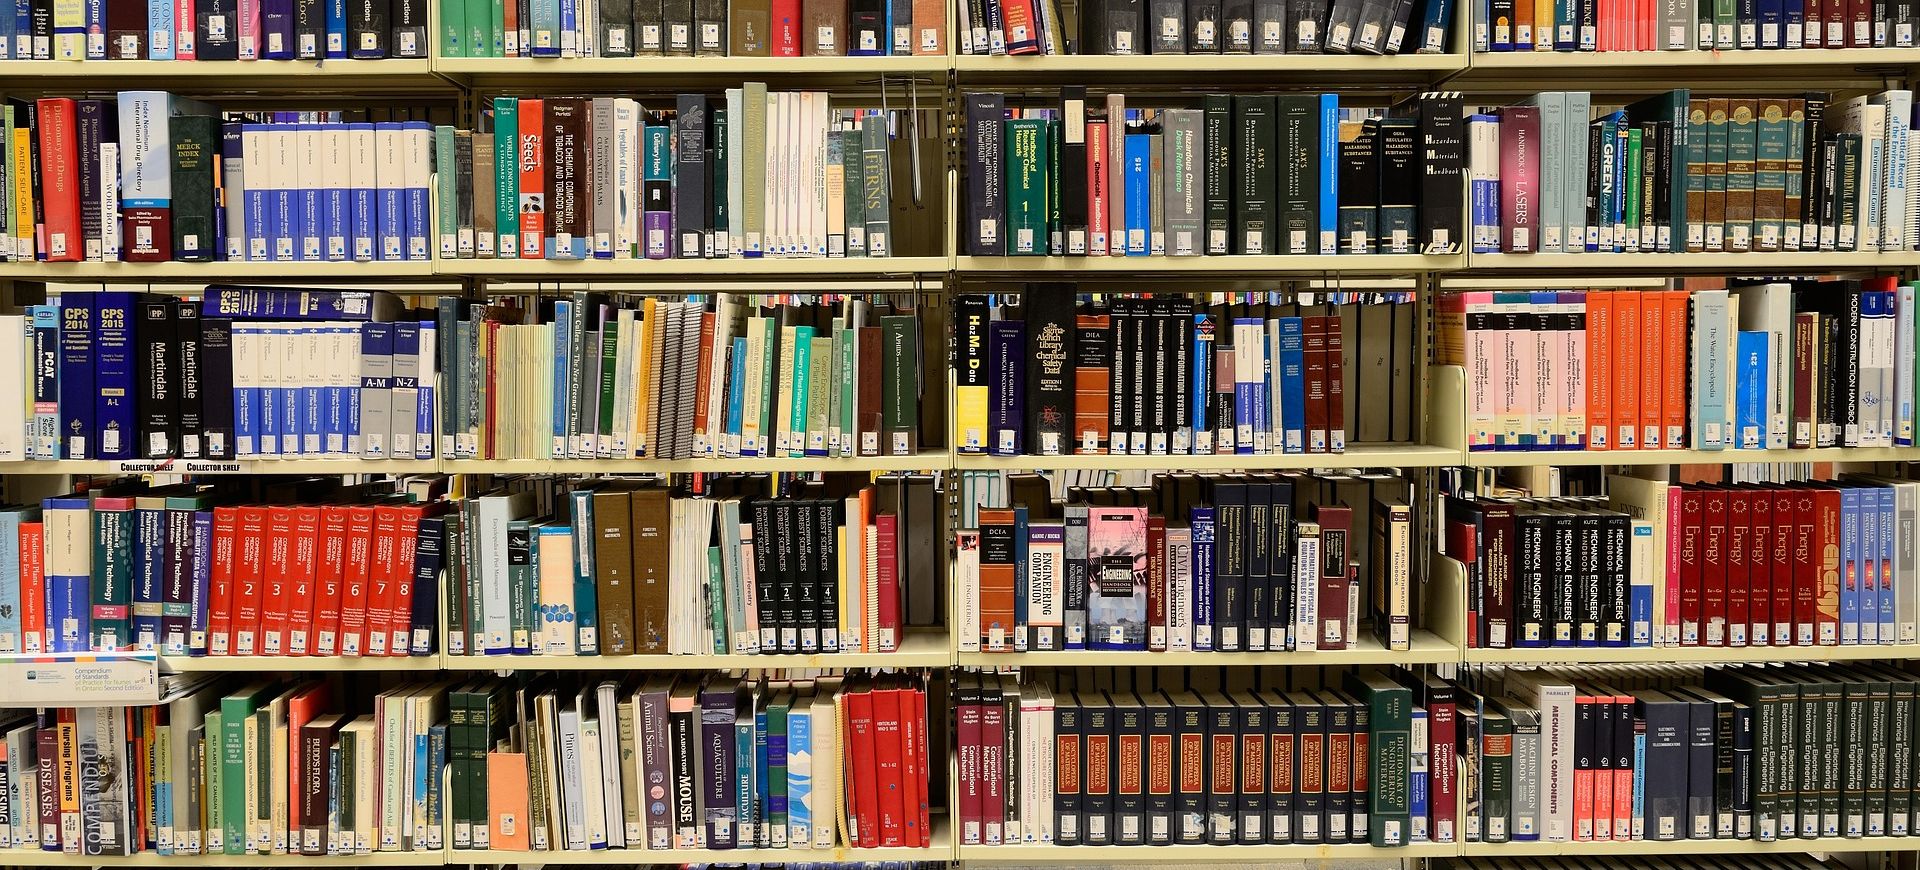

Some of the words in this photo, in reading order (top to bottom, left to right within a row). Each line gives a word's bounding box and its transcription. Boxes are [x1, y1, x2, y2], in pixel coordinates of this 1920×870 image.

[92, 0, 100, 23] GUIDE
[54, 105, 62, 153] Dictionary
[556, 125, 563, 133] OF
[565, 134, 573, 146] THE
[1093, 126, 1101, 161] Hazardous
[1425, 134, 1460, 144] Hazardous
[1899, 124, 1908, 160] Statistical
[57, 155, 63, 164] of
[523, 134, 538, 172] Seeds
[565, 148, 573, 179] CHEMICAL
[1030, 164, 1037, 172] of
[1426, 150, 1459, 160] Materials
[866, 154, 880, 209] FERNS
[1093, 162, 1101, 196] Chemicals
[1426, 165, 1459, 175] Handbook
[1519, 168, 1525, 176] OF
[1603, 143, 1614, 194] GREEN
[1872, 147, 1880, 192] Environmental
[565, 182, 574, 224] COMPONENTS
[1516, 181, 1528, 224] LASERS
[65, 308, 89, 319] CPS
[101, 309, 124, 319] CPS
[220, 290, 230, 314] CPS
[231, 291, 240, 314] 2015
[310, 297, 319, 311] M-Z
[65, 320, 88, 329] 2014
[102, 320, 124, 328] 2015
[969, 315, 980, 358] HazMat
[1036, 352, 1066, 360] Chemical
[1039, 342, 1063, 350] Library
[45, 352, 54, 378] PCAT
[156, 342, 165, 400] Martindale
[186, 342, 196, 399] Martindale
[969, 359, 980, 383] Data
[1043, 360, 1062, 368] Safety
[366, 379, 386, 387] A-M
[396, 378, 414, 387] N-Z
[1114, 395, 1122, 425] SYSTEMS
[187, 463, 221, 471] COLLECTOR
[1682, 525, 1700, 565] Energy
[1706, 525, 1724, 565] Energy
[1730, 526, 1748, 565] Energy
[1752, 526, 1769, 565] Energy
[1775, 525, 1792, 564] Energy
[1796, 524, 1814, 564] Energy
[1102, 566, 1132, 581] ENGINEERING
[1177, 545, 1188, 578] CIVIL
[104, 564, 113, 601] Technology
[219, 584, 224, 595] 1
[245, 584, 253, 595] 2
[272, 584, 280, 596] 3
[297, 584, 306, 595] 4
[327, 584, 335, 595] 5
[351, 584, 359, 596] 6
[377, 583, 386, 594] 7
[400, 584, 408, 595] 8
[1032, 552, 1041, 605] COMPANION
[1043, 552, 1052, 616] ENGINEERING
[1176, 580, 1187, 627] Engineer's
[1533, 573, 1542, 621] ENGINEERS'
[1564, 574, 1573, 622] ENGINEERS'
[1616, 574, 1625, 622] ENGINEERS'
[644, 701, 652, 733] Animal
[1551, 705, 1559, 757] MECHANICAL
[63, 726, 72, 757] Nursing
[714, 733, 722, 799] AQUACULTURE
[1528, 738, 1536, 776] MACHINE
[41, 758, 52, 817] DISEASES
[64, 758, 72, 802] Programs
[313, 768, 321, 795] FLORA
[680, 777, 692, 822] MOUSE
[1397, 797, 1403, 808] OF
